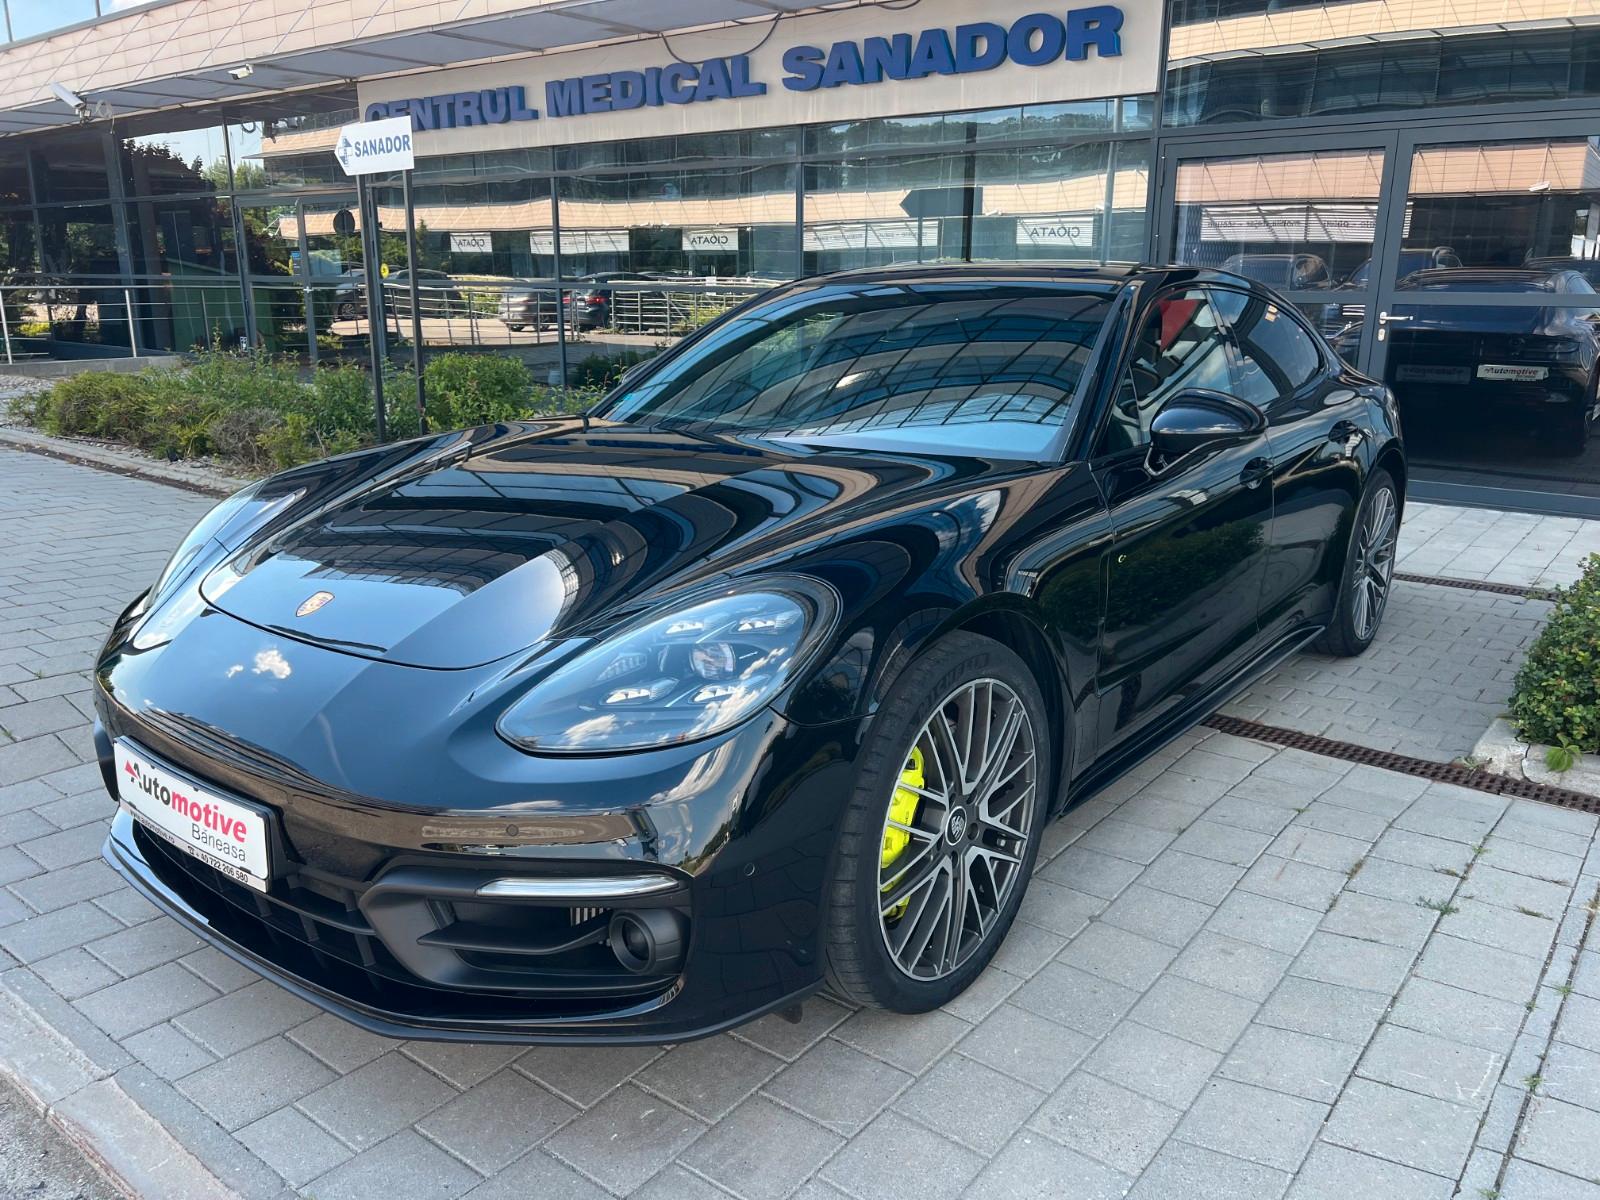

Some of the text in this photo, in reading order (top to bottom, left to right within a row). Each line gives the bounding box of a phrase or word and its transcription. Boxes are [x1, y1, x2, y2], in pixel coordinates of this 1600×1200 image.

[545, 54, 767, 118] MEDICAL
[782, 5, 1125, 92] SANADOR
[354, 134, 411, 158] SANADOR
[1485, 367, 1538, 376] Automotive
[124, 760, 247, 843] Automotive
[222, 863, 235, 876] 206
[236, 870, 249, 883] 580
